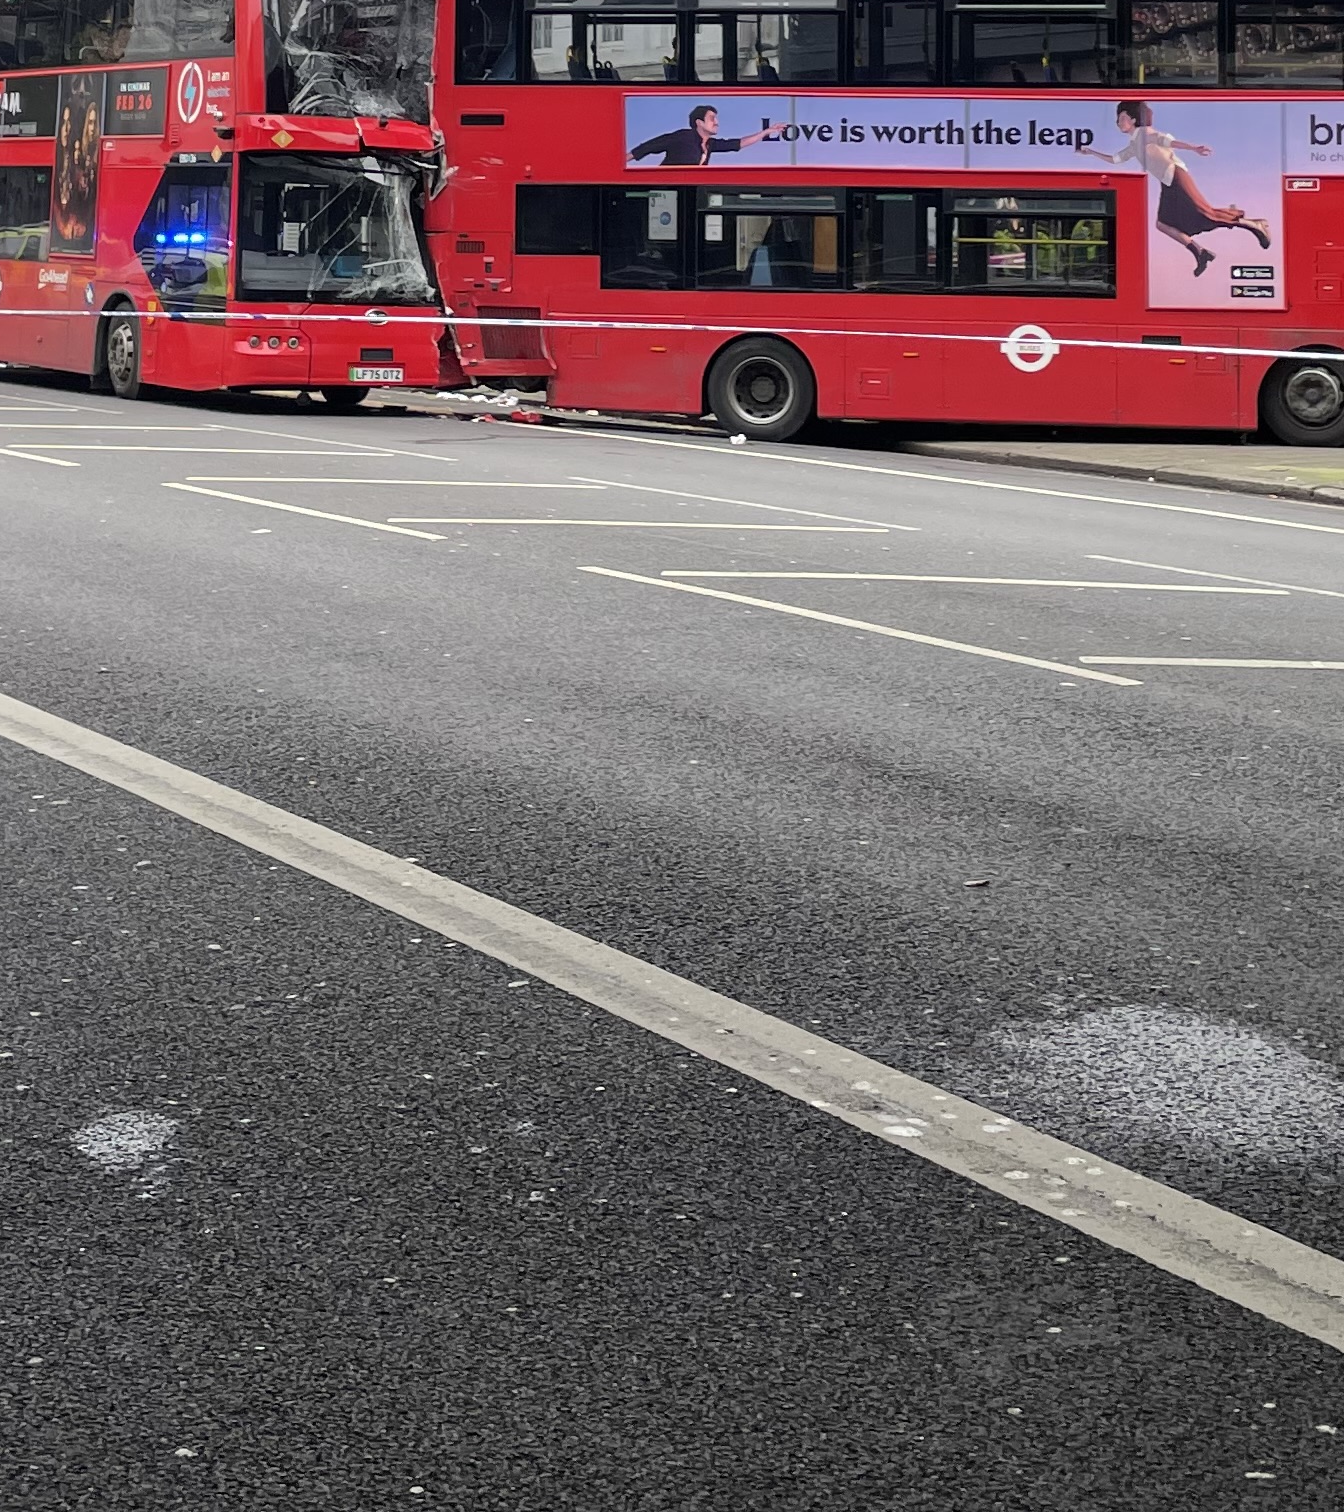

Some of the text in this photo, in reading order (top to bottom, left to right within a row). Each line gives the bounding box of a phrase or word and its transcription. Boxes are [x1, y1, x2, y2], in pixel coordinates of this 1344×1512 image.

[116, 93, 153, 111] FEB 26
[761, 116, 1094, 153] Love is worth the leap
[1310, 152, 1327, 162] No
[356, 369, 381, 380] LF75
